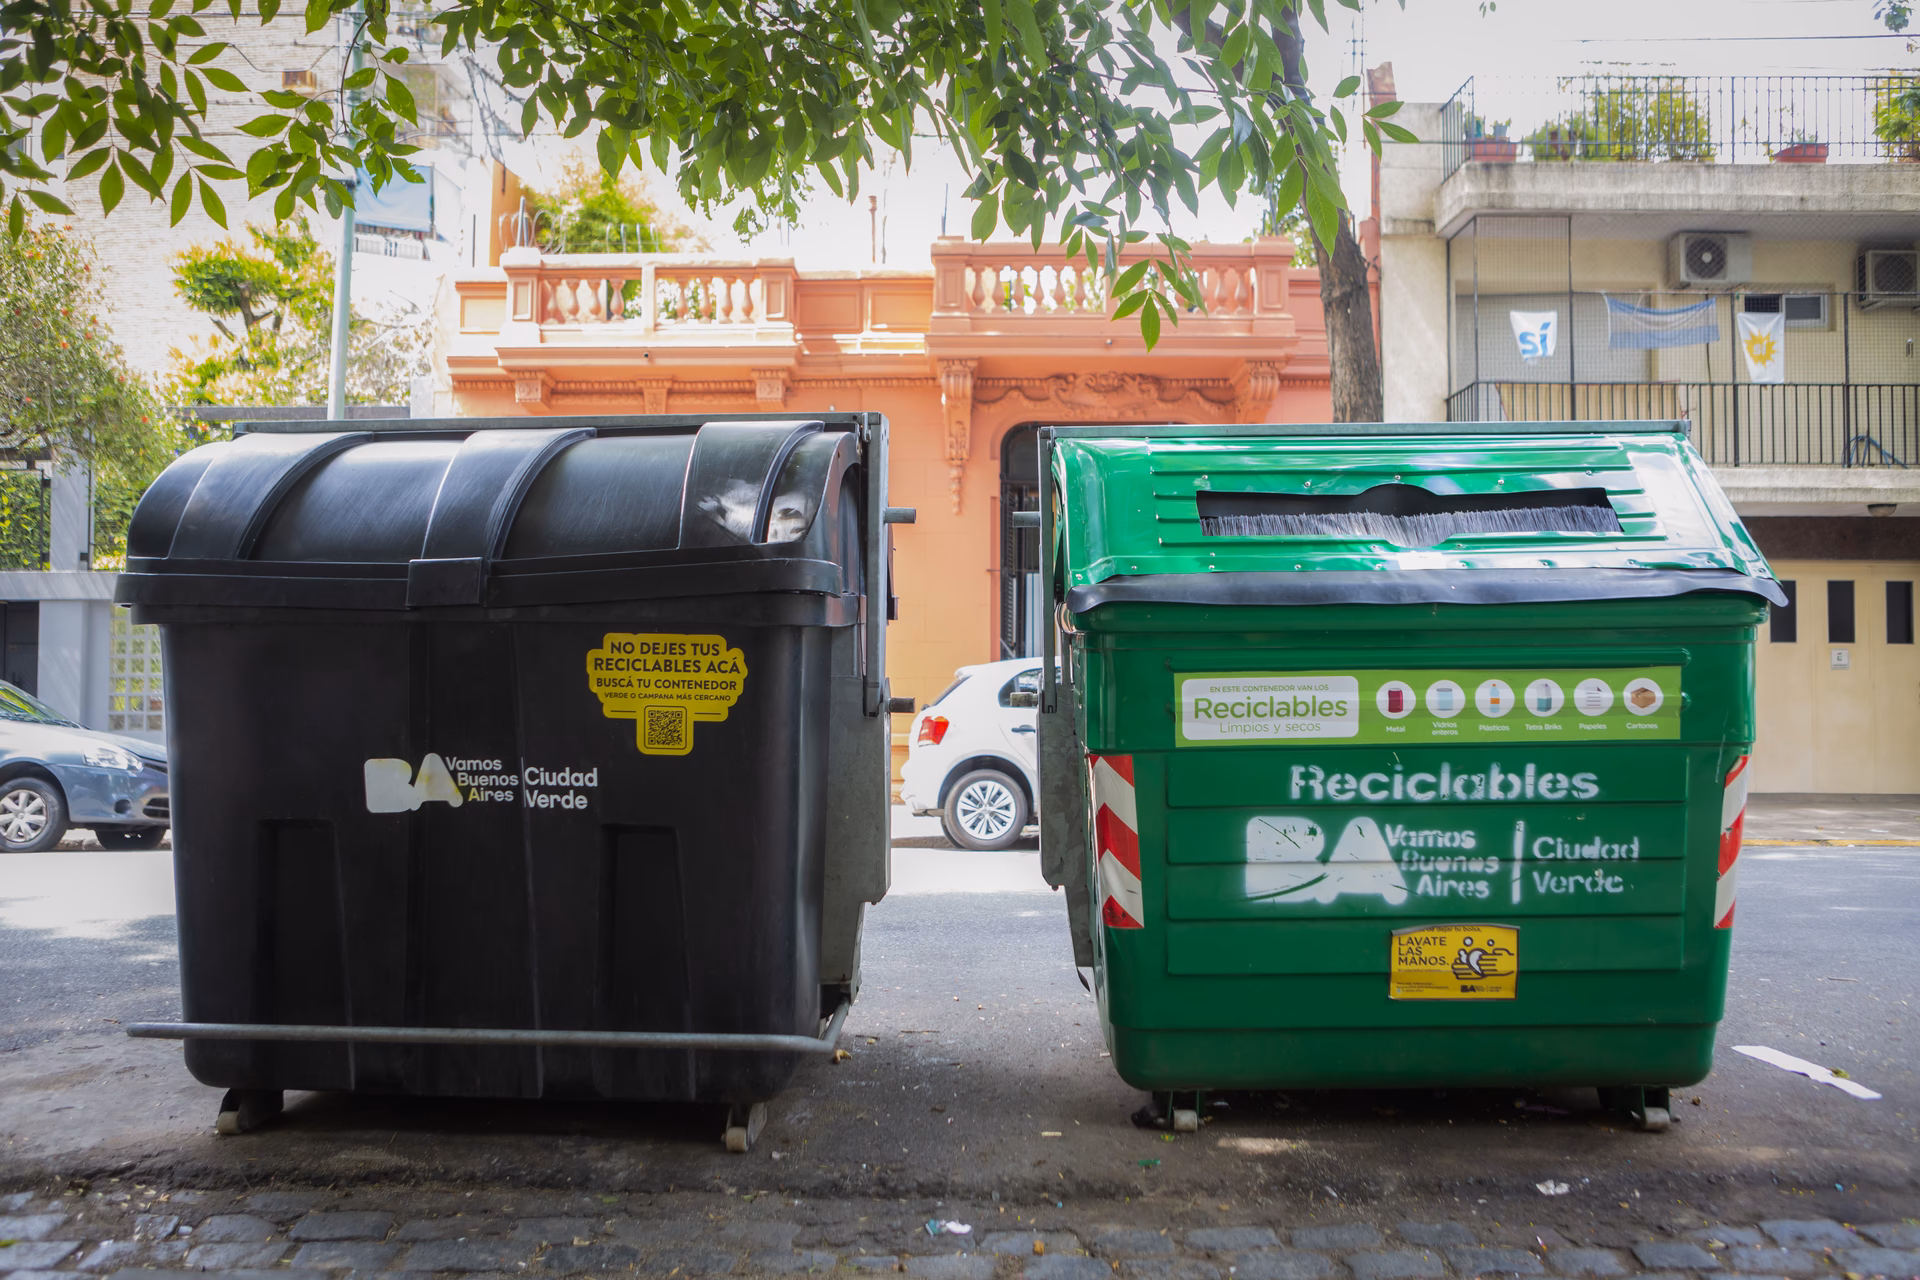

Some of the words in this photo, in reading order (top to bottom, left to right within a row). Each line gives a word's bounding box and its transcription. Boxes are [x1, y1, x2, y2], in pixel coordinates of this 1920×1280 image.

[610, 641, 635, 655] NO
[640, 642, 687, 656] DEJES
[691, 643, 720, 657] TUS
[593, 657, 701, 673] RECICLABLES
[706, 657, 741, 674] ACÁ
[596, 676, 634, 688] BUSCÁ
[637, 678, 651, 688] TU
[654, 679, 737, 690] CONTENEDOR
[638, 692, 674, 700] CAMPANA
[676, 692, 692, 701] MÁS
[1194, 695, 1348, 719] Reciclables
[1219, 722, 1269, 734] Limpios
[1273, 723, 1281, 734] y
[1285, 723, 1321, 732] secos
[1432, 721, 1458, 729] Vidrios
[445, 757, 502, 771] Vamos
[457, 772, 519, 786] Buenos
[524, 766, 598, 786] Ciudad
[1289, 762, 1600, 801] Reciclables
[468, 788, 514, 802] Aires
[525, 789, 588, 809] Verde
[1384, 824, 1477, 849] Vamos
[1532, 835, 1641, 861] Ciudad
[1401, 850, 1500, 874] Buenos
[1417, 875, 1491, 899] Aires
[1532, 868, 1625, 894] Verde
[1398, 936, 1447, 947] LAVATE
[1398, 946, 1423, 956] LAS
[1398, 956, 1450, 966] MANOS.
